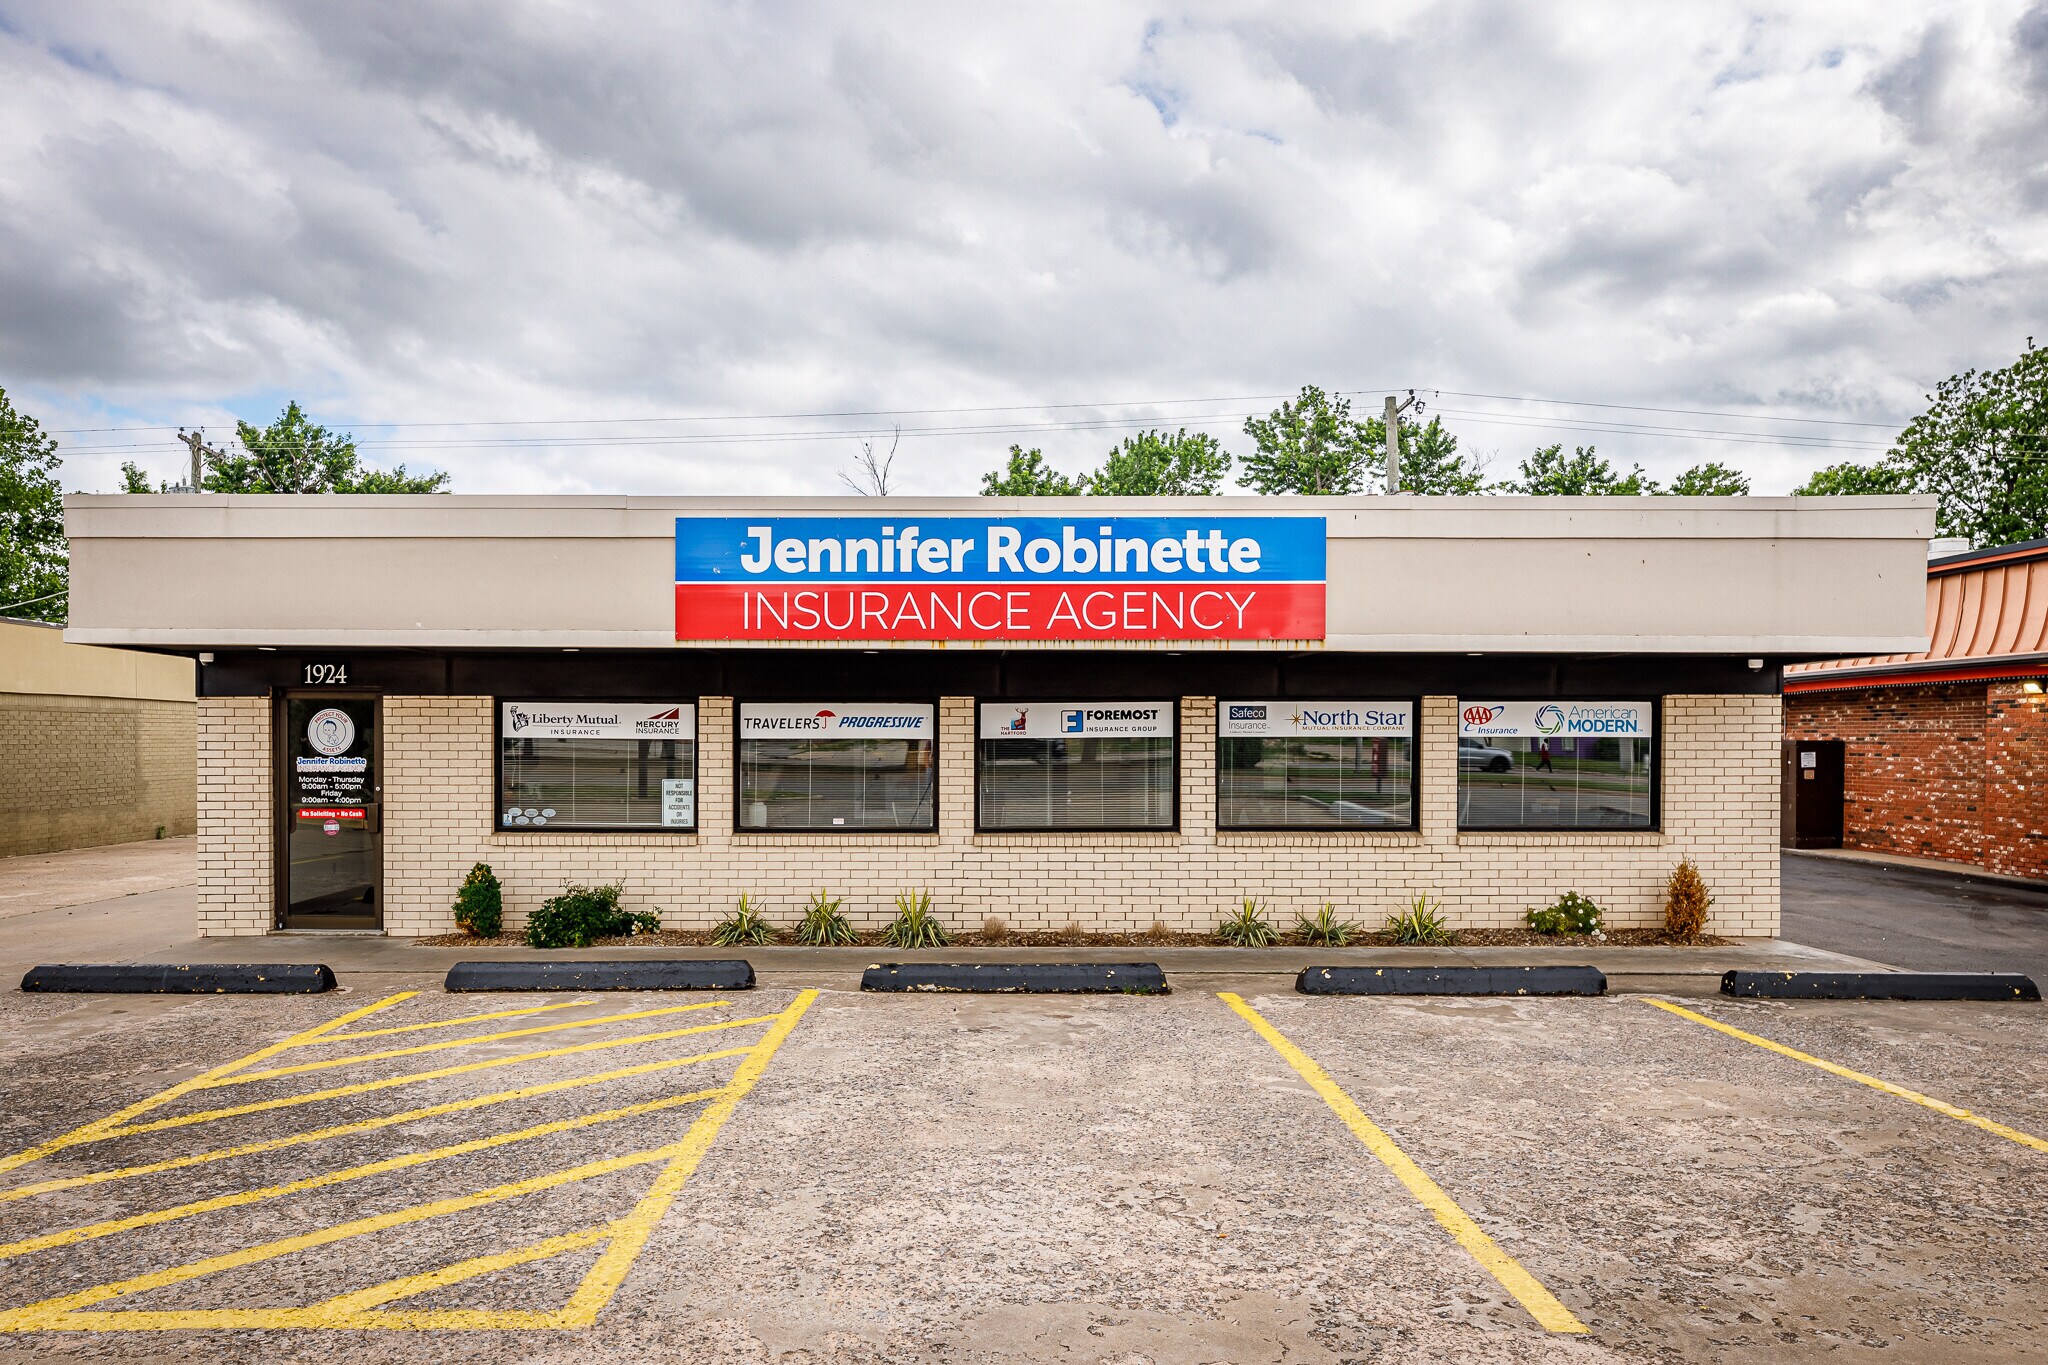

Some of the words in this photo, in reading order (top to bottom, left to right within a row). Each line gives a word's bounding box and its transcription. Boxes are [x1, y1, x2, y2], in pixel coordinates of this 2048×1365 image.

[740, 526, 975, 574] Jennifer
[987, 526, 1261, 574] Robinette
[743, 591, 1031, 630] INSURANCE
[1046, 591, 1257, 630] AGENCY
[304, 664, 347, 684] 1924
[314, 711, 335, 724] PROTECT
[335, 712, 348, 724] YOUR
[1086, 709, 1158, 721] FOREMOST
[1231, 707, 1265, 718] Safeco
[1303, 709, 1359, 726] North
[1365, 710, 1406, 726] Star
[1465, 708, 1491, 725] AAA
[1569, 706, 1637, 719] American
[531, 713, 573, 728] Liberty
[635, 720, 680, 728] MERCURY
[744, 717, 820, 730] TRAVELERS
[838, 716, 925, 728] PROGRESSIVE
[1228, 721, 1267, 730] Insurance
[1477, 727, 1518, 735] Insurance
[297, 757, 328, 765] Jennifer
[330, 757, 366, 765] Robinette
[298, 776, 327, 784] Monday
[332, 776, 365, 784] Thursday
[334, 796, 362, 804] 4:00pm
